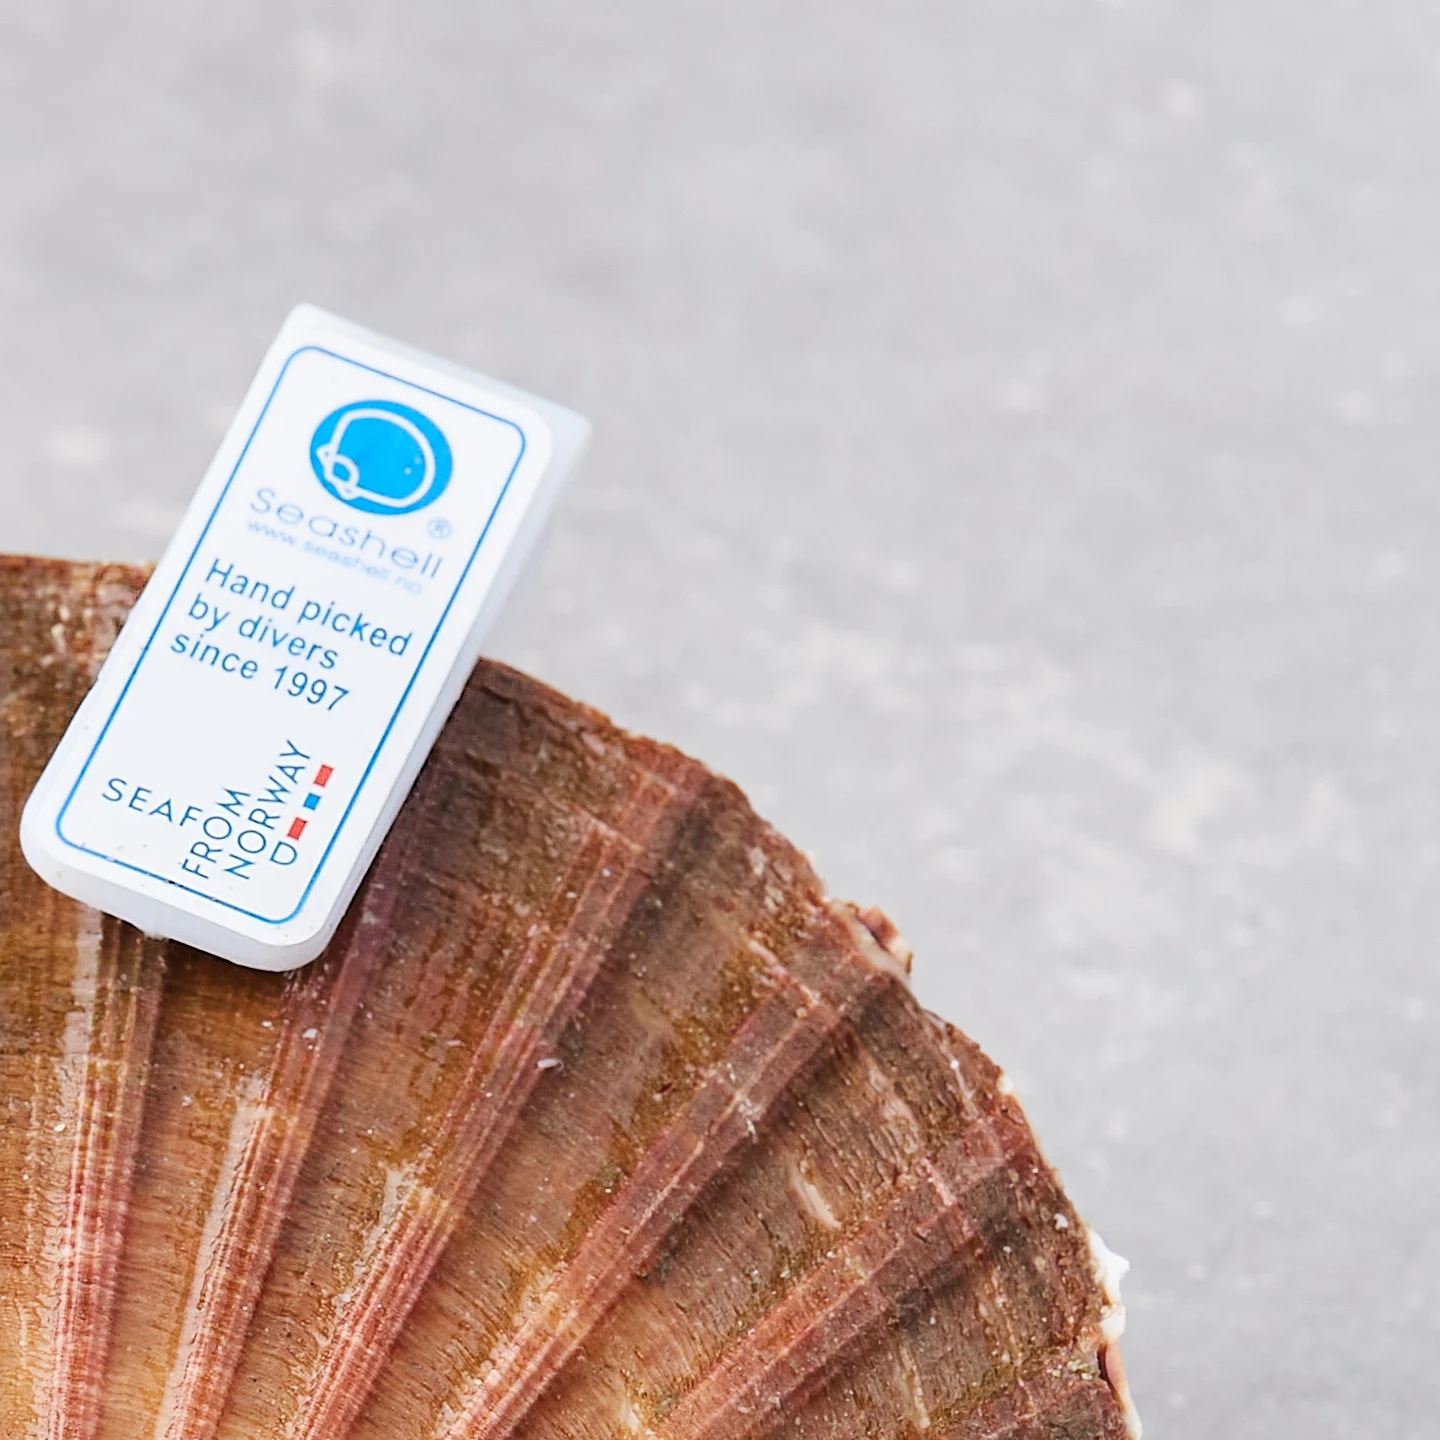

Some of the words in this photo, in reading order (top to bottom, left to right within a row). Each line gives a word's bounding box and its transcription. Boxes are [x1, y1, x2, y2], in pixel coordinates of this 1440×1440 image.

[250, 487, 443, 580] Seashell
[187, 592, 230, 632] by
[238, 614, 340, 669] divers
[205, 557, 296, 610] Hand
[297, 600, 413, 656] picked
[170, 632, 259, 679] since
[273, 665, 349, 711] 1997
[181, 787, 252, 880] FROM
[223, 739, 311, 880] NORWAY
